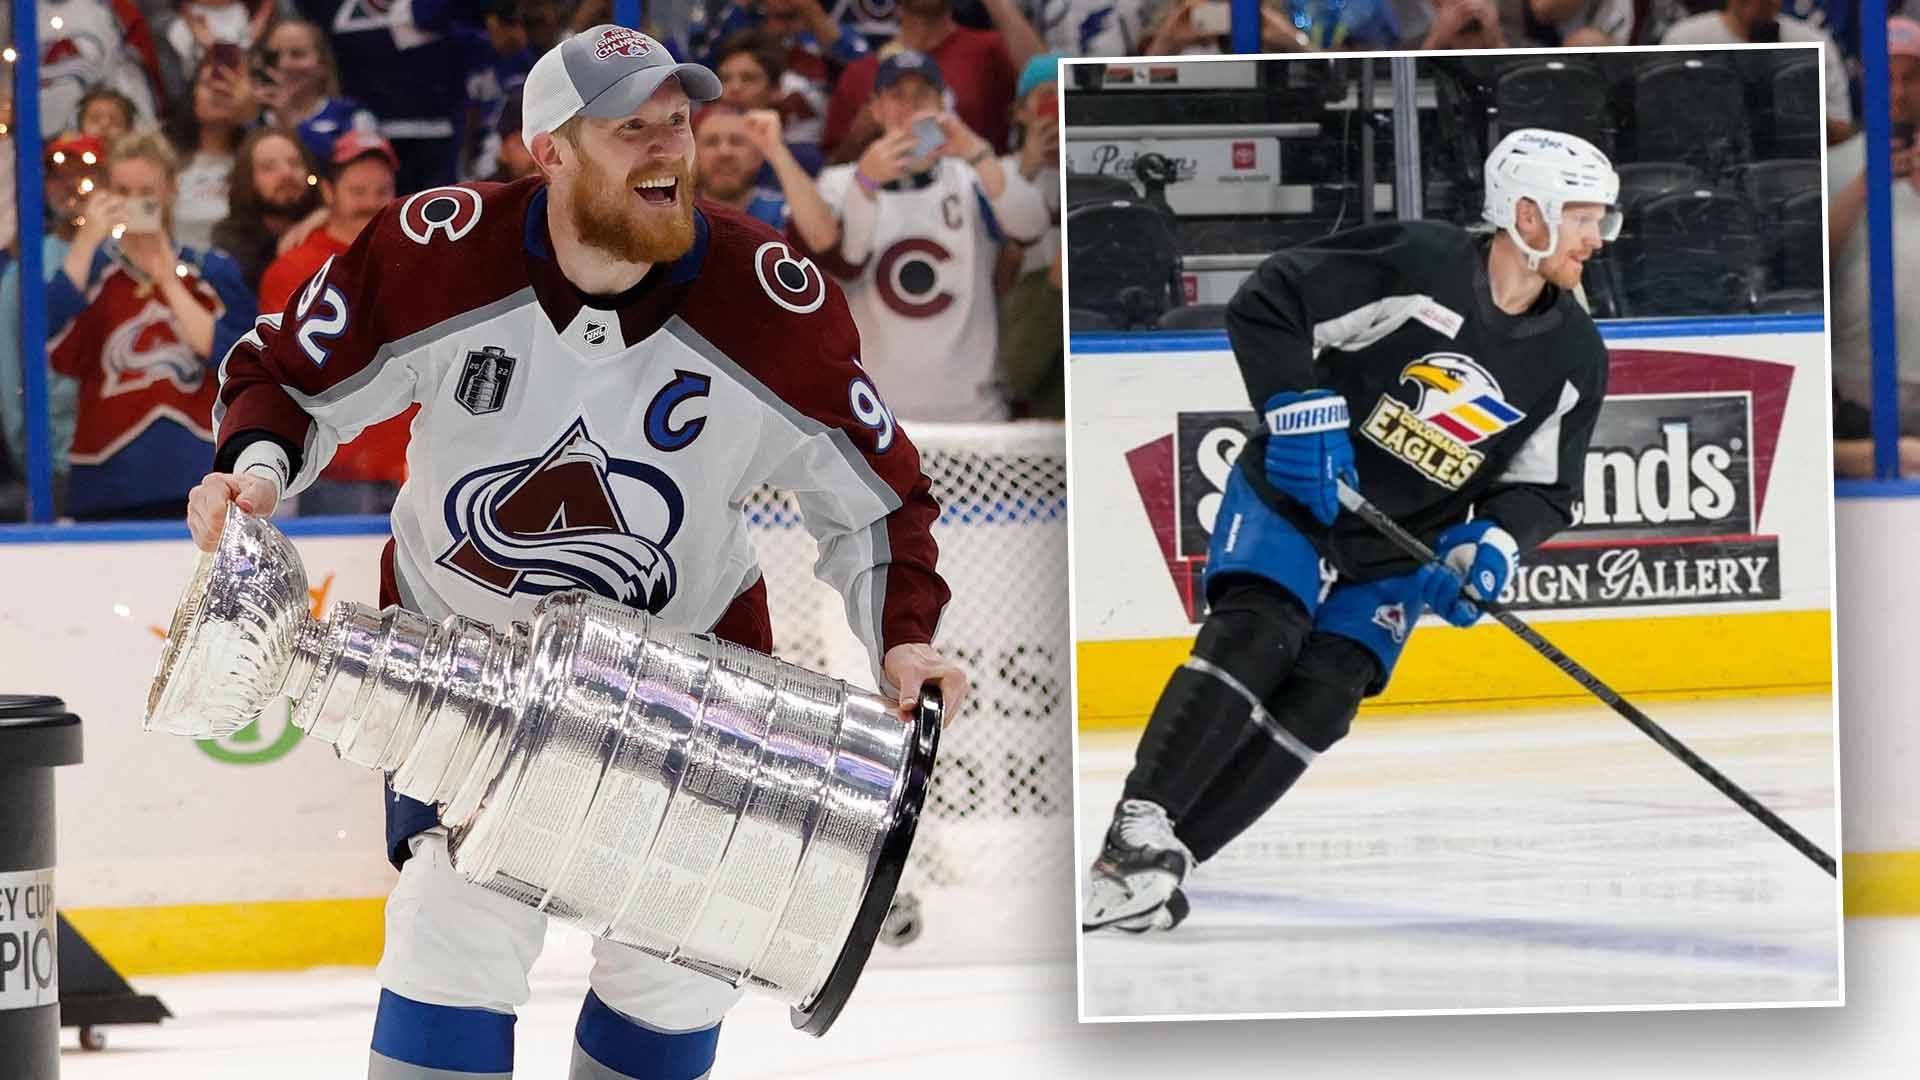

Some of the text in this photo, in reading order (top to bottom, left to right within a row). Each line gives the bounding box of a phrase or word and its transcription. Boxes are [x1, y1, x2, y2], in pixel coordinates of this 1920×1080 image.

[586, 325, 606, 341] NHL
[643, 369, 711, 452] C
[848, 376, 897, 453] 9
[1400, 412, 1469, 460] COLORADO
[1363, 399, 1481, 487] EAGLES
[1597, 548, 1770, 600] GALLERY
